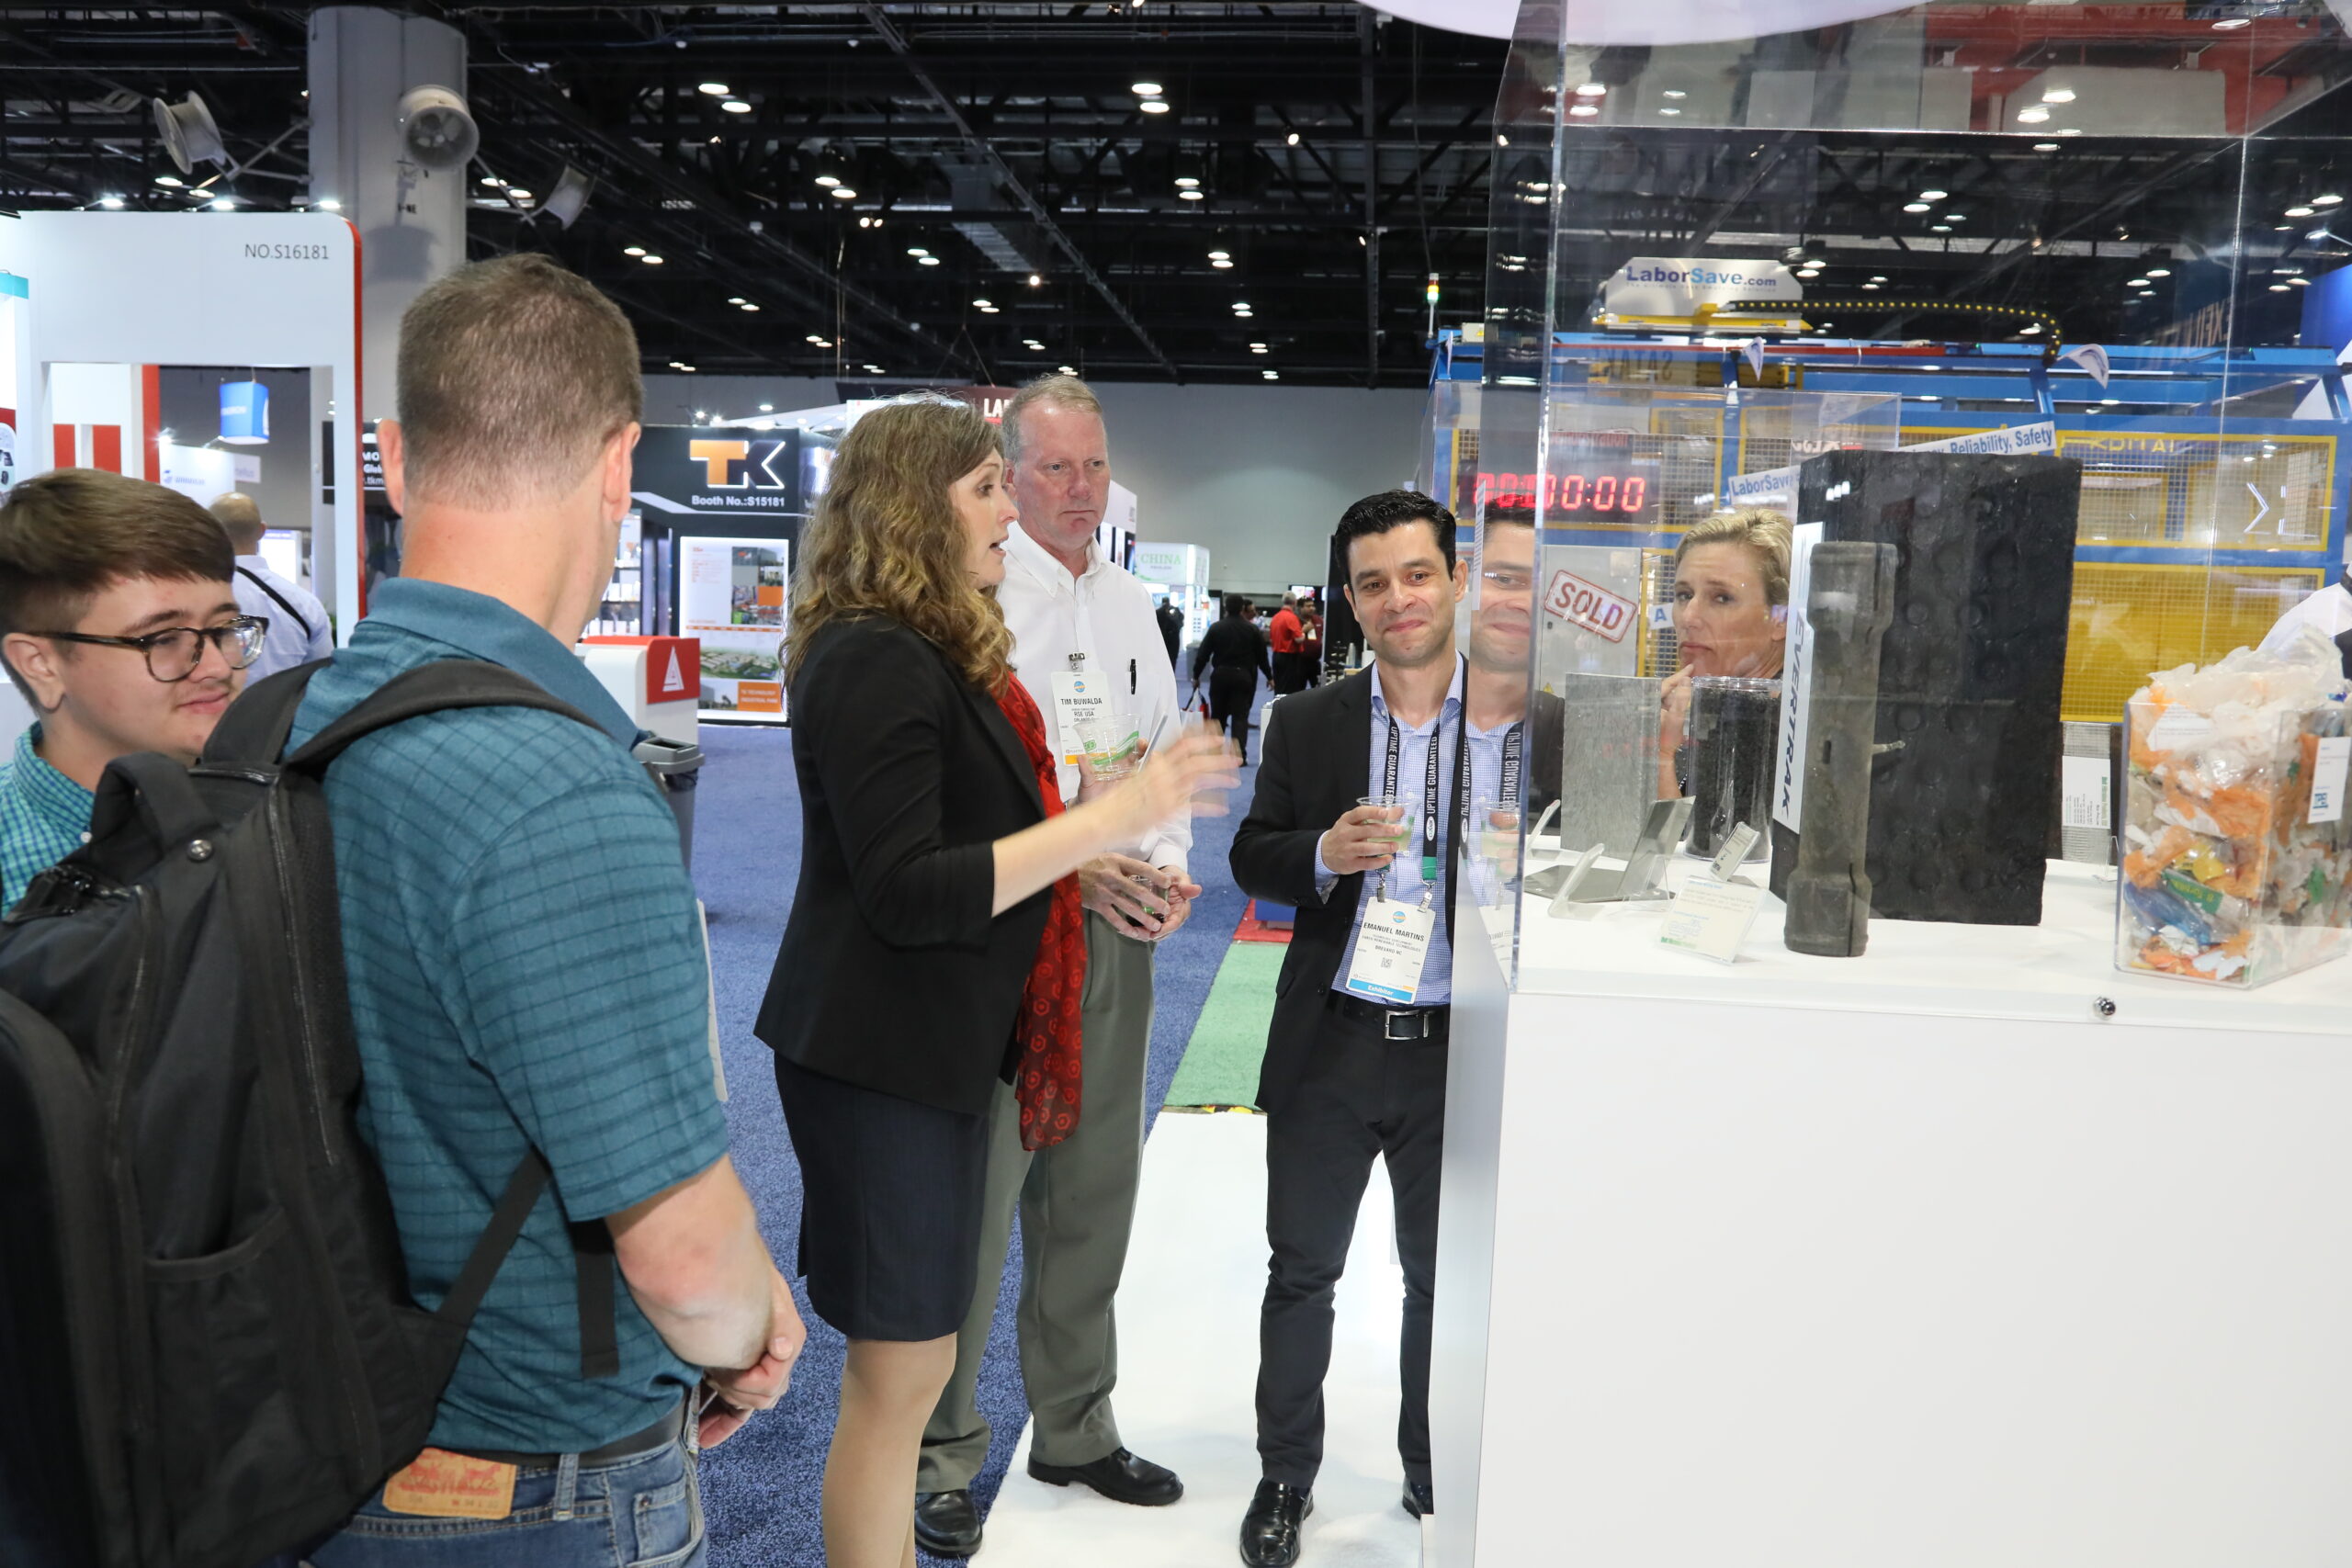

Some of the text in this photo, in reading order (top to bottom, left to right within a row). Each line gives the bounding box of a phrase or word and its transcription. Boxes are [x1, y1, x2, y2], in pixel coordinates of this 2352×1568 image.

[244, 243, 330, 260] NO.S16181
[1626, 265, 1777, 288] LaborSave.com
[2015, 427, 2052, 448] Safety
[690, 439, 786, 490] TK
[691, 494, 786, 507] Booth No.:S15181
[1140, 553, 1182, 566] CHINA
[1555, 581, 1624, 630] SOLD
[1073, 697, 1102, 705] BUWALDA
[1781, 610, 1804, 818] EVERTRAK
[1387, 726, 1398, 752] UPTIME
[1427, 736, 1438, 814] UPTIME GUARANTEED
[1363, 921, 1425, 942] EMANUEL MARTINS
[1367, 985, 1395, 996] Exhibitor
